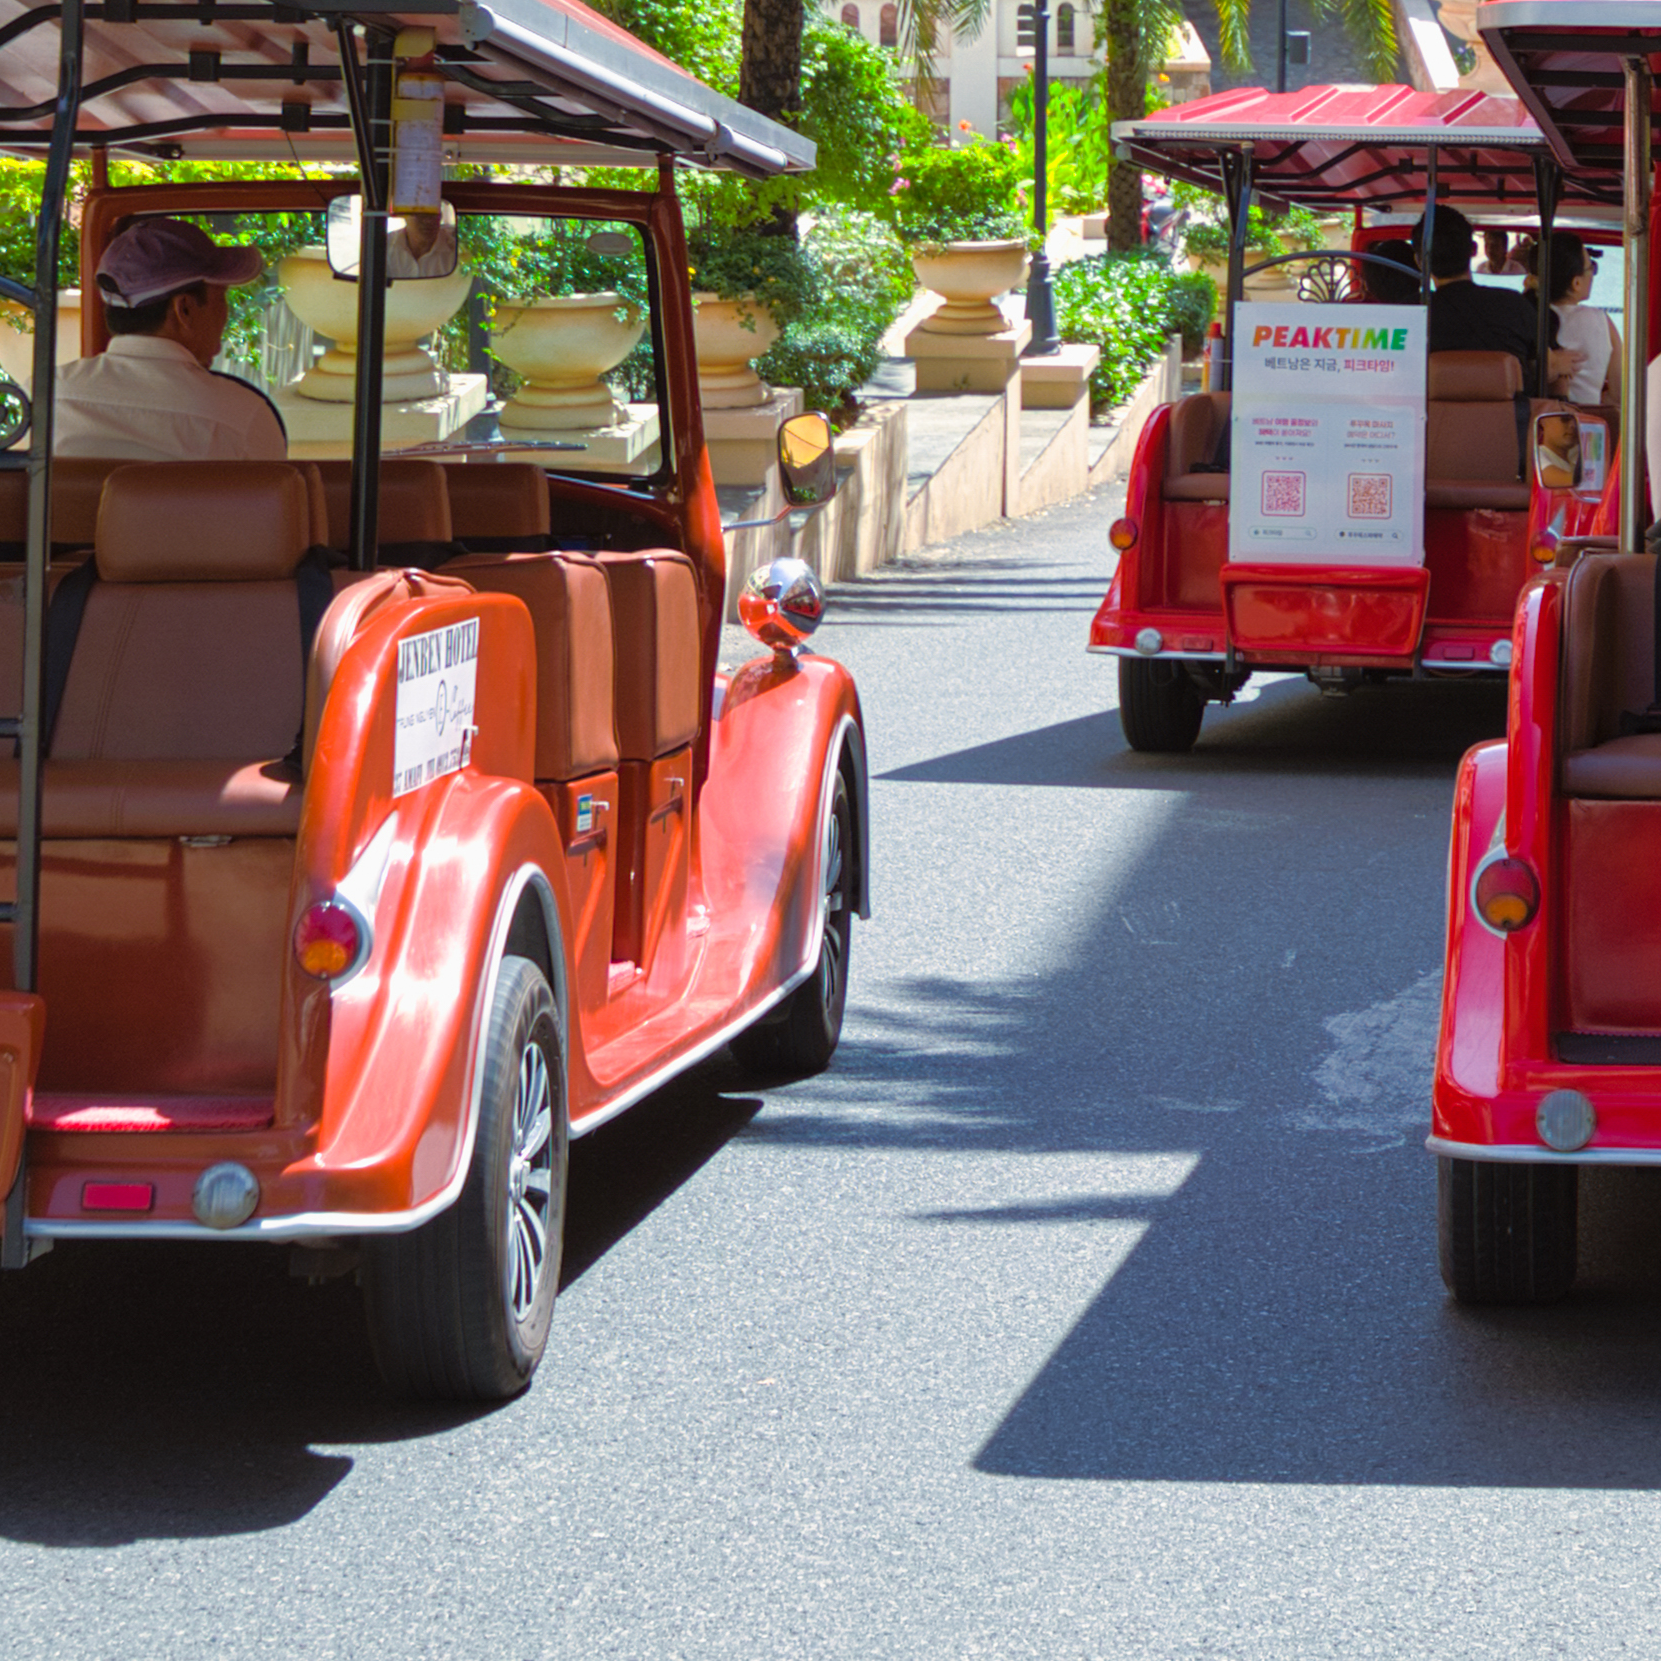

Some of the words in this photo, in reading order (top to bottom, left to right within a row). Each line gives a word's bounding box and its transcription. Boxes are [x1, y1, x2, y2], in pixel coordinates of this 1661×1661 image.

[1252, 325, 1408, 351] PEAKTIME
[1264, 357, 1311, 371] 베트남은
[1314, 357, 1341, 373] 지금,
[1343, 359, 1395, 373] 피크타임!
[445, 620, 477, 669] HOTEL
